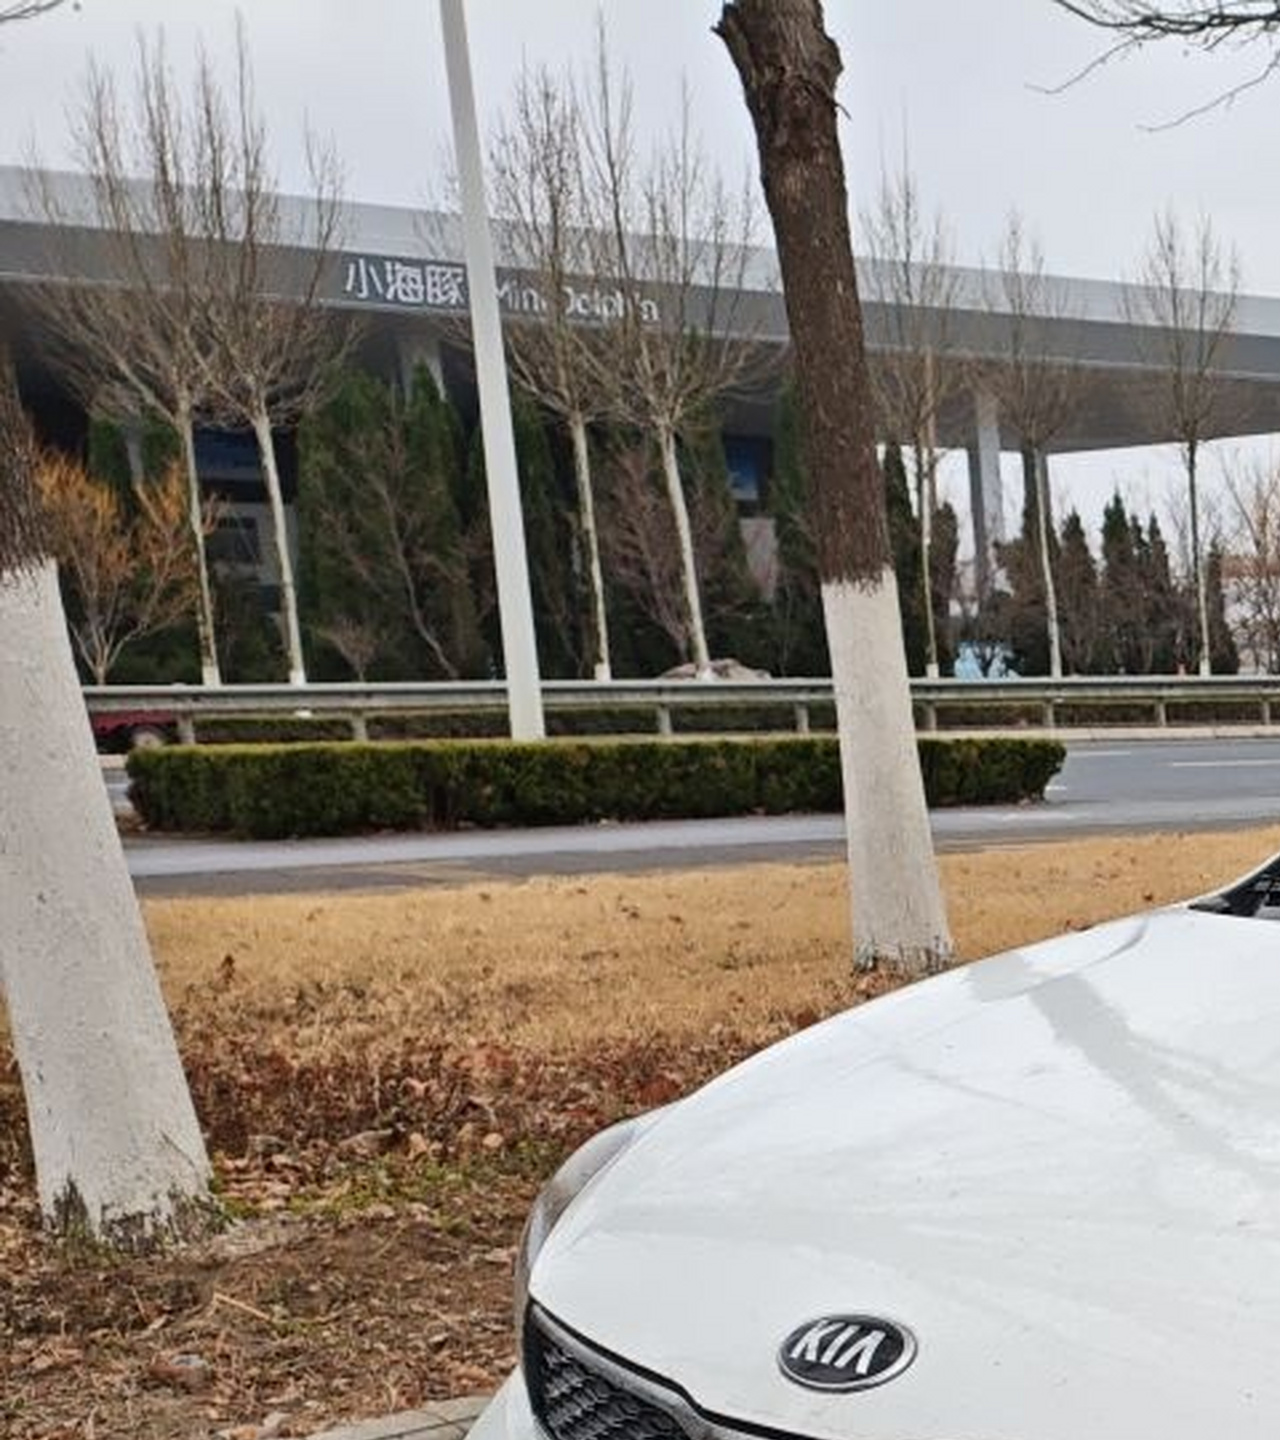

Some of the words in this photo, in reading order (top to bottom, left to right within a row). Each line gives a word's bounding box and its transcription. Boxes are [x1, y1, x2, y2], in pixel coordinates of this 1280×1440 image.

[345, 258, 465, 304] 小海豚
[790, 1319, 887, 1375] KIA
